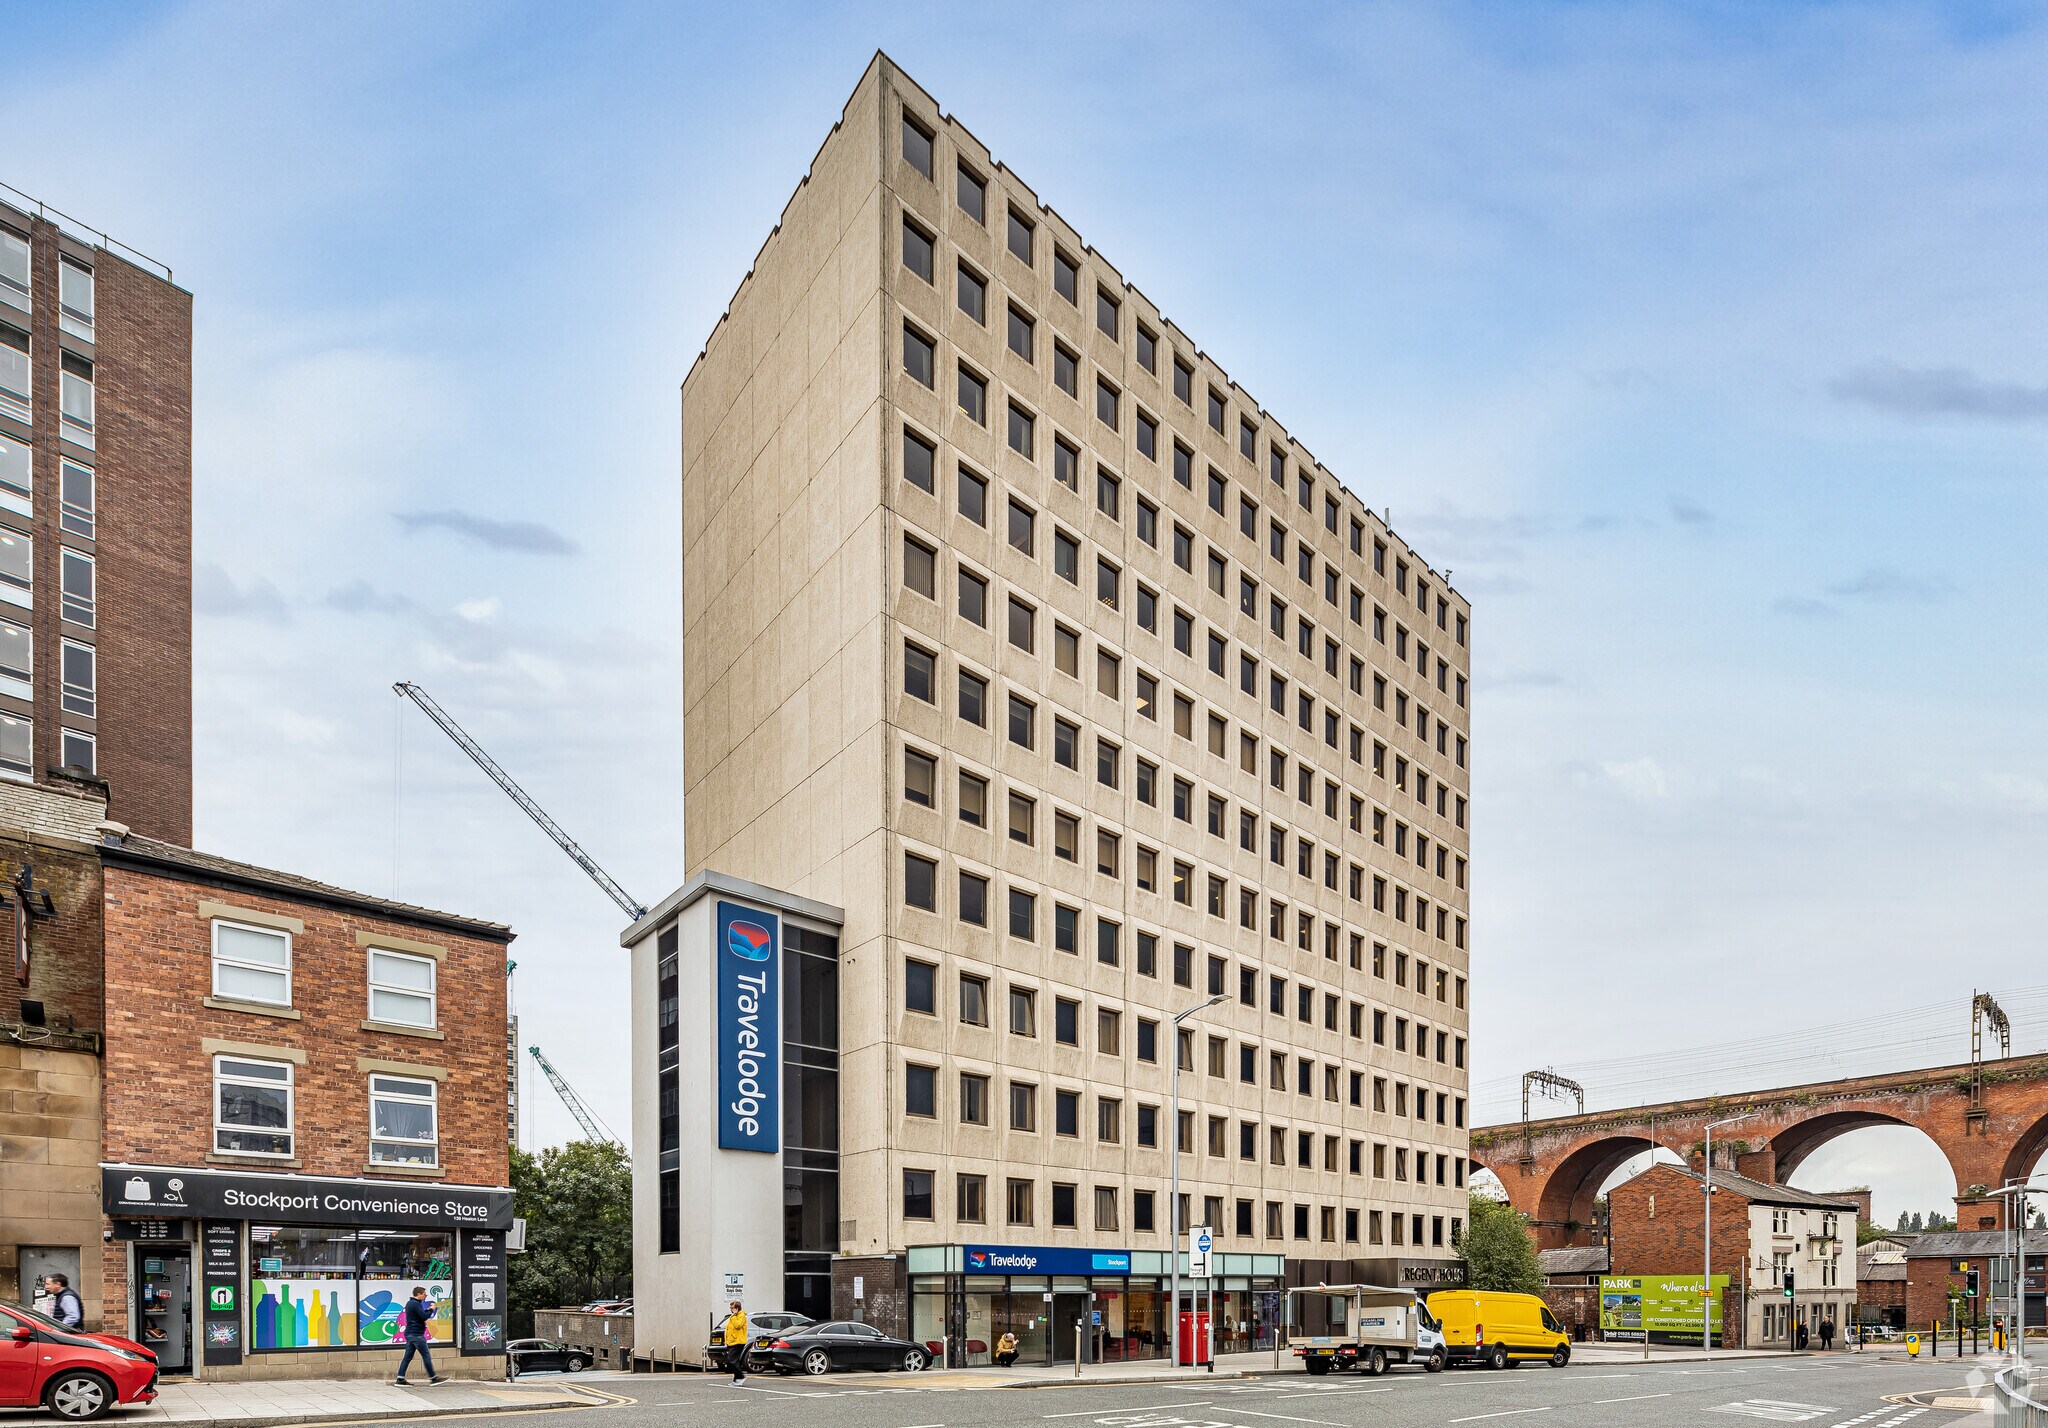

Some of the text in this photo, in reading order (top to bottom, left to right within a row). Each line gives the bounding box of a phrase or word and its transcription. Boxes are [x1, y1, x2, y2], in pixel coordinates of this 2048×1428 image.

[732, 971, 766, 1136] Travelodge
[223, 1189, 488, 1217] Stockport Convenience Store
[988, 1253, 1037, 1270] Travelodge
[1107, 1259, 1127, 1267] Stockport
[1404, 1267, 1437, 1281] REGENT
[1603, 1279, 1632, 1289] PARK
[1661, 1281, 1688, 1292] Where
